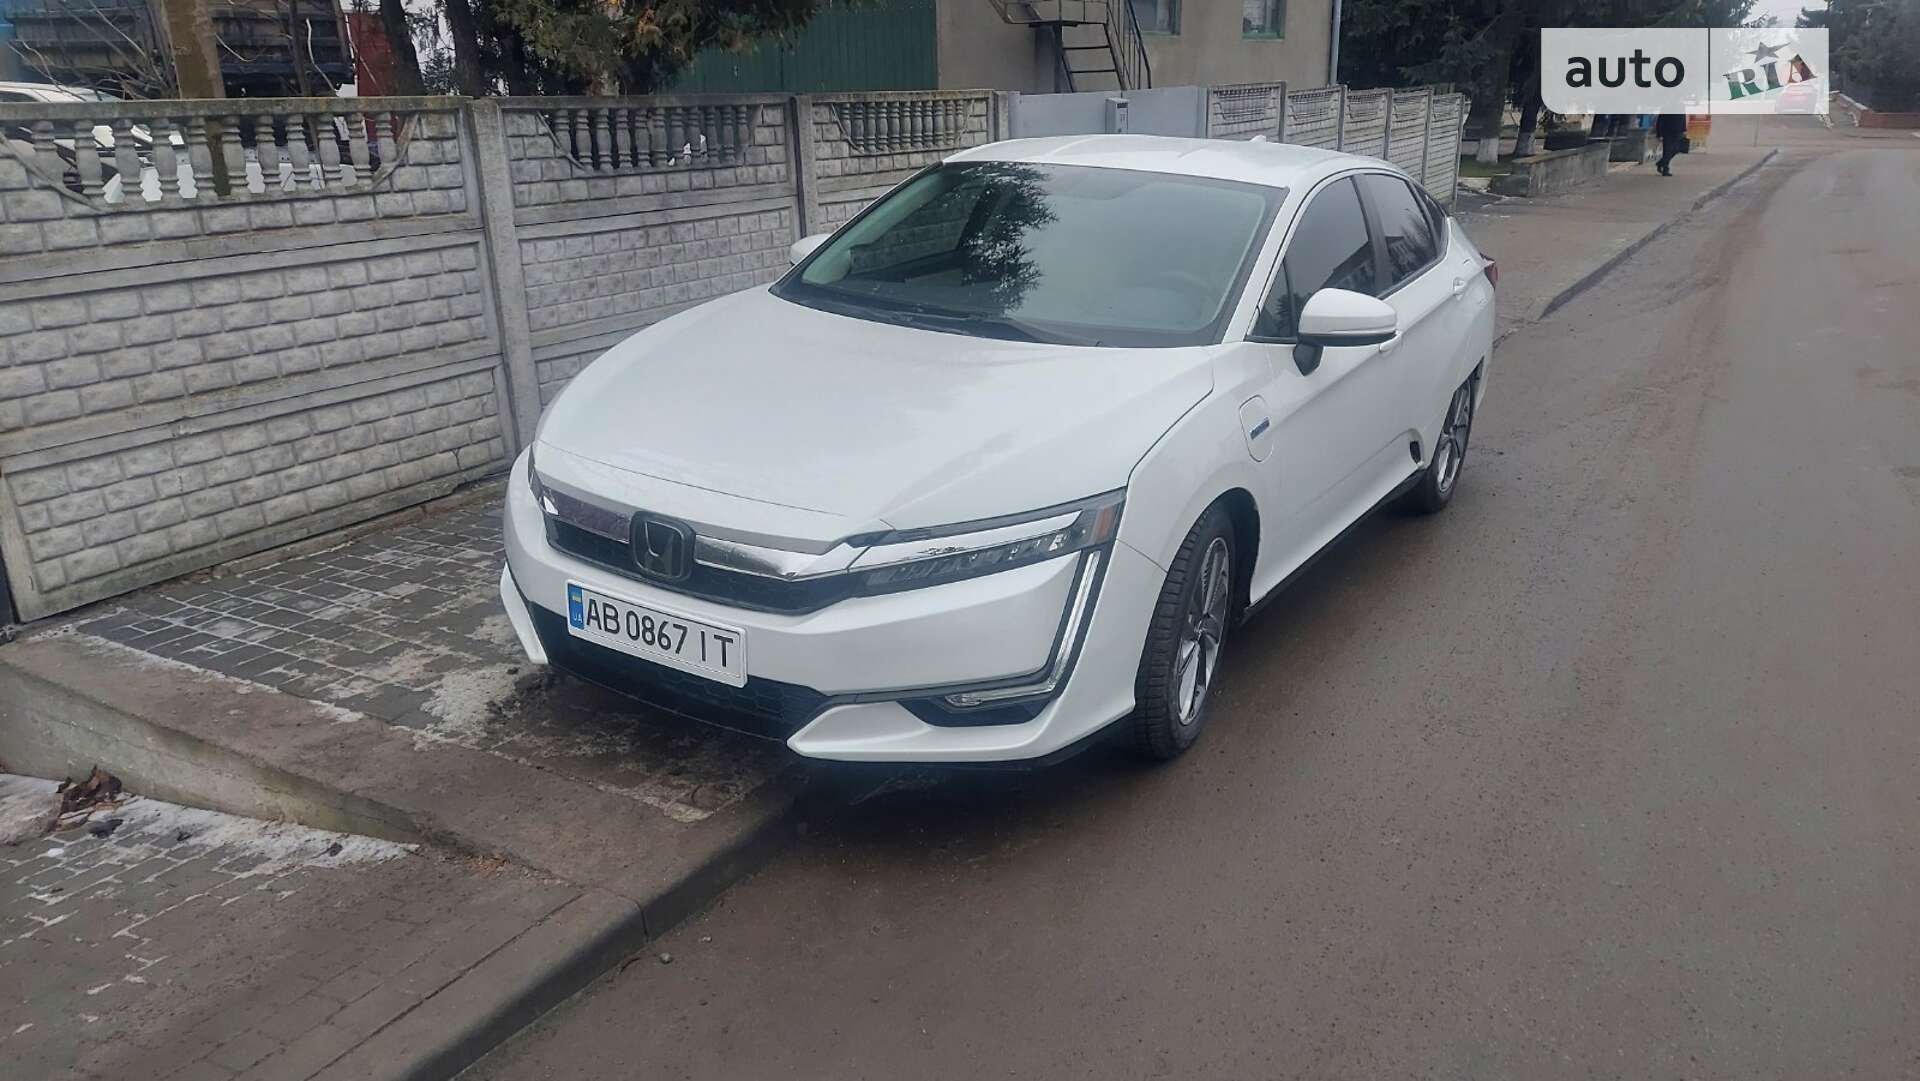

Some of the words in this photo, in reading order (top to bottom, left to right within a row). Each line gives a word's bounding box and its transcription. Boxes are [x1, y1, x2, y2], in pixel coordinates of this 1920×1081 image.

[586, 598, 621, 635] AB
[625, 610, 688, 655] 0867
[700, 630, 734, 667] IT
